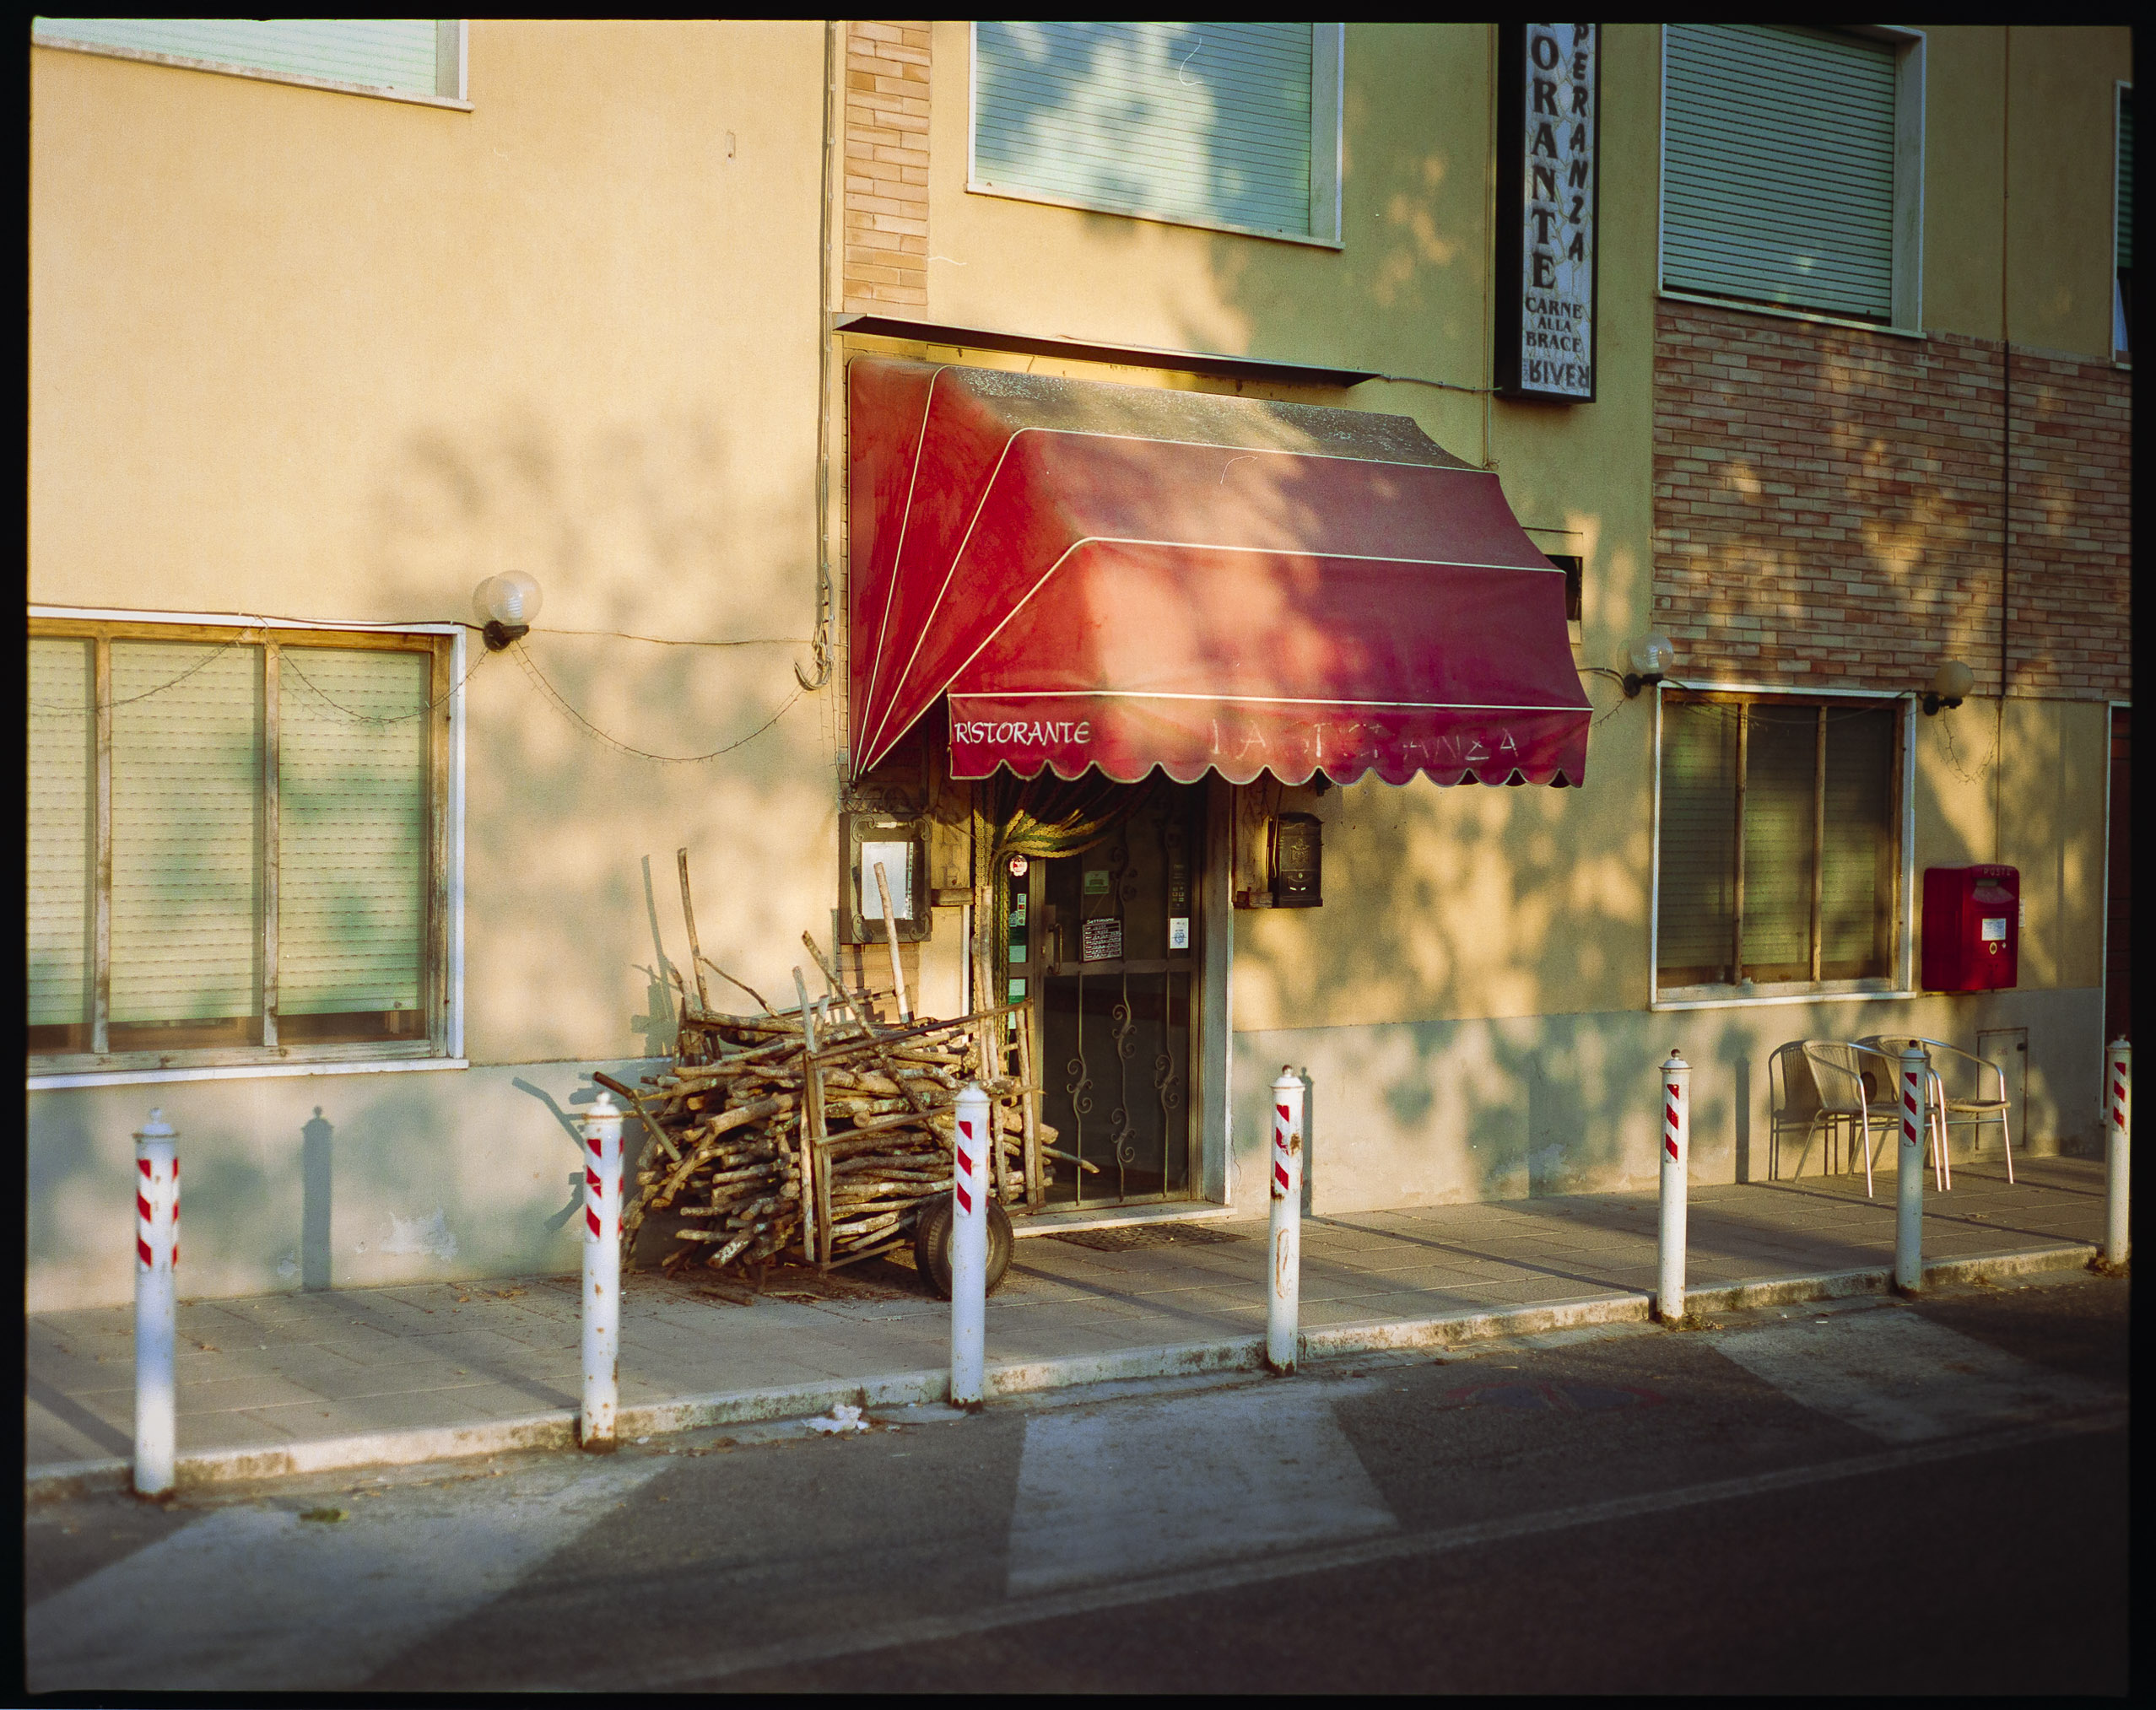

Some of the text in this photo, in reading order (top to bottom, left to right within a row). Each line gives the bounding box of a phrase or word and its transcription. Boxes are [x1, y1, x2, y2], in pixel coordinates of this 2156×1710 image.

[1530, 24, 1559, 289] ORANTE
[1525, 297, 1583, 320] CARNE
[1537, 316, 1571, 332] ALLA
[1526, 331, 1583, 353] BRACE
[954, 721, 1091, 746] RISTORANTE
[1289, 722, 1519, 762] ANZA
